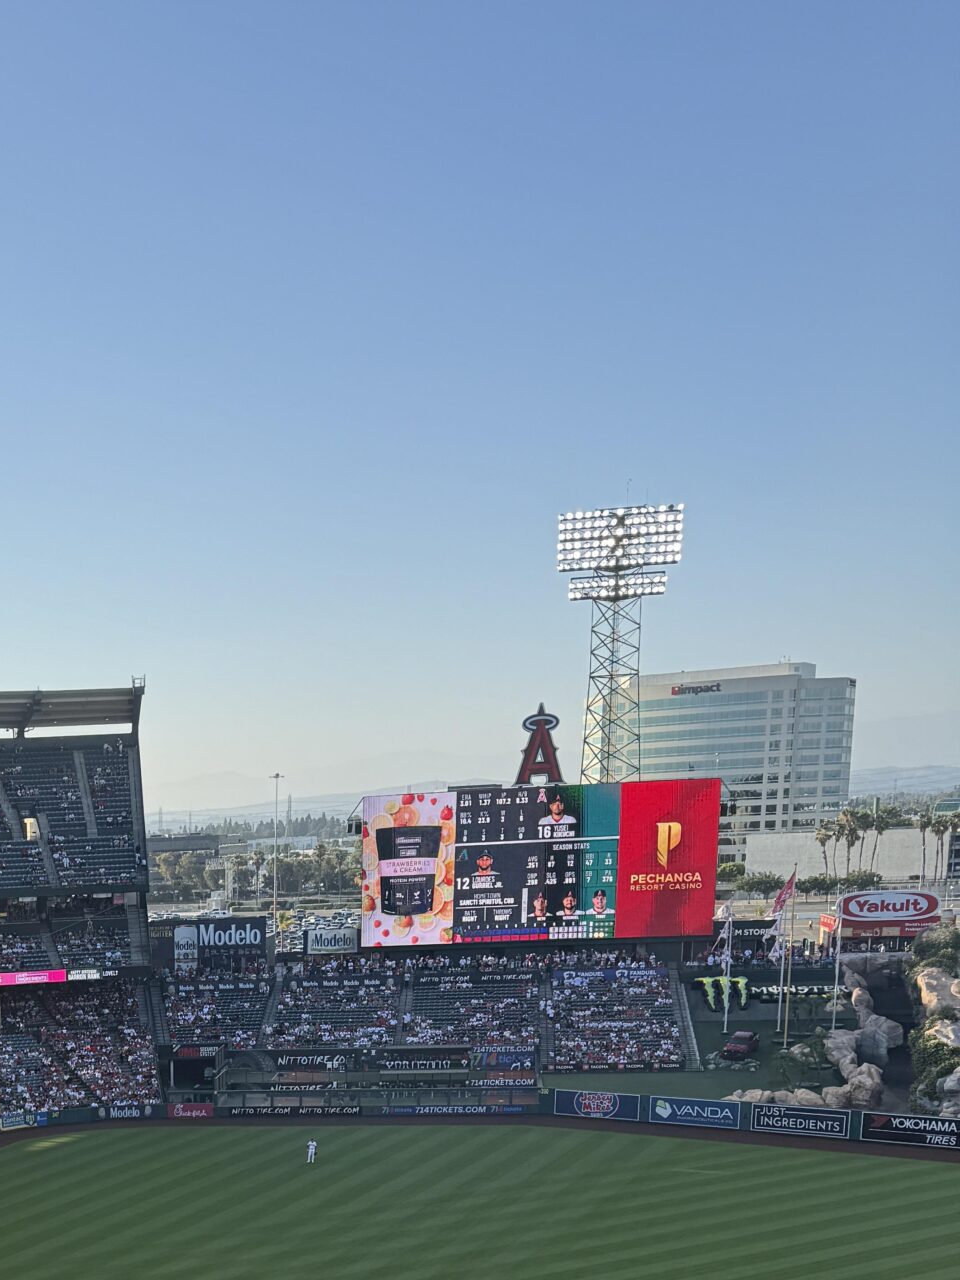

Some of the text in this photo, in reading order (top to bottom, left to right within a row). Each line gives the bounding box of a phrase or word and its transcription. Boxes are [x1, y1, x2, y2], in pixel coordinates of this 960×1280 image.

[680, 683, 721, 695] impact
[538, 826, 551, 838] 16
[456, 878, 469, 890] 12
[630, 873, 701, 884] PECHANGA
[854, 899, 924, 912] Yakult
[199, 924, 261, 946] Modelo
[313, 933, 351, 947] Modelo
[579, 1093, 614, 1102] Jersey
[110, 1107, 140, 1118] Modelo
[231, 1107, 291, 1115] NITTO TIRE.COM
[299, 1107, 322, 1115] NITTO
[672, 1104, 734, 1119] VANDA
[760, 1107, 786, 1116] JUST
[760, 1116, 840, 1132] INGREDIENTS
[891, 1117, 957, 1132] YOKOHAMA
[926, 1135, 957, 1145] TIRES
